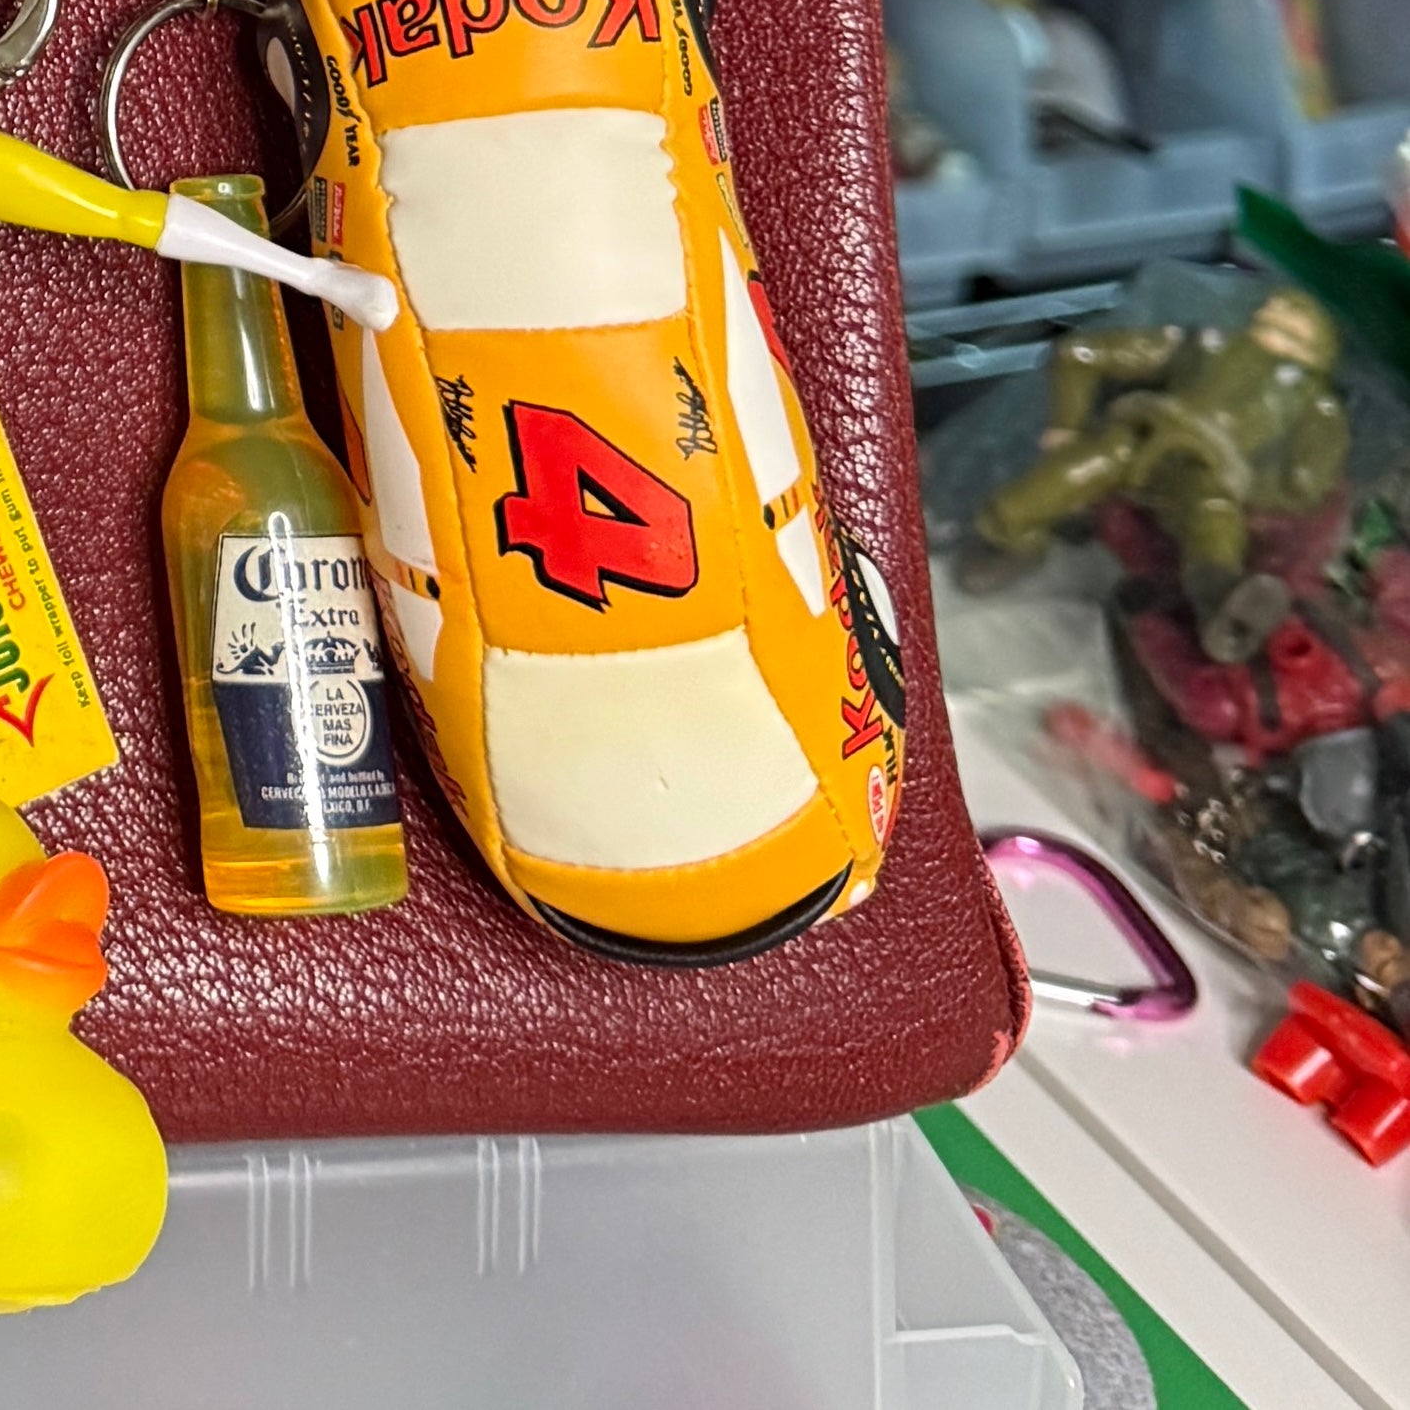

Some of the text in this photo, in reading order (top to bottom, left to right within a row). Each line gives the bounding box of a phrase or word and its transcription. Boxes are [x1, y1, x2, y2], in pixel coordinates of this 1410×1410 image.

[0, 488, 23, 522] gum
[493, 399, 699, 613] 4
[14, 527, 34, 552] put
[27, 558, 41, 576] to
[233, 544, 368, 603] Coron
[33, 578, 65, 639] wrapper
[55, 641, 75, 668] foil
[70, 669, 91, 709] Keep
[326, 688, 344, 701] LA
[322, 718, 352, 731] MAS
[323, 733, 353, 746] FINA
